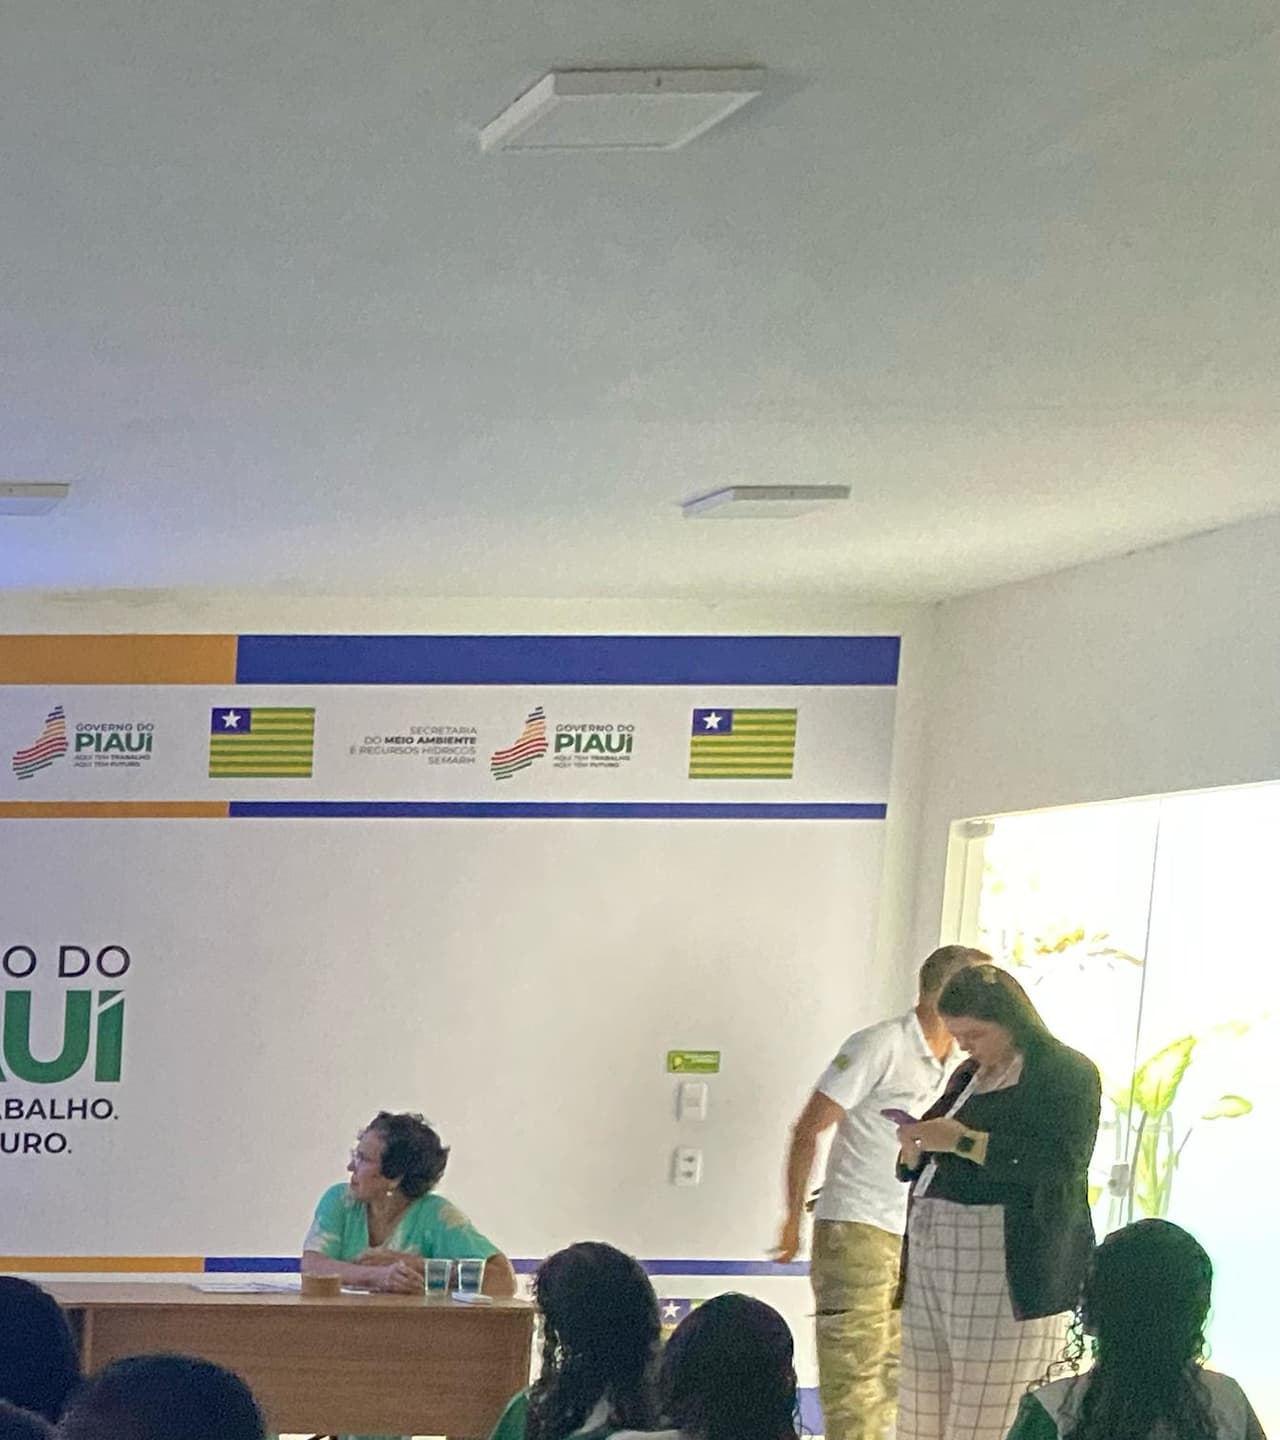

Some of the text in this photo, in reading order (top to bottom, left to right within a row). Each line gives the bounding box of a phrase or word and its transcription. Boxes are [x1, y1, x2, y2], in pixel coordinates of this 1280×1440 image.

[75, 723, 154, 732] GOVERNO DO
[555, 723, 634, 732] GOVERNO DO
[364, 736, 477, 745] DO MEIO AMBIENTE
[57, 944, 131, 979] DO
